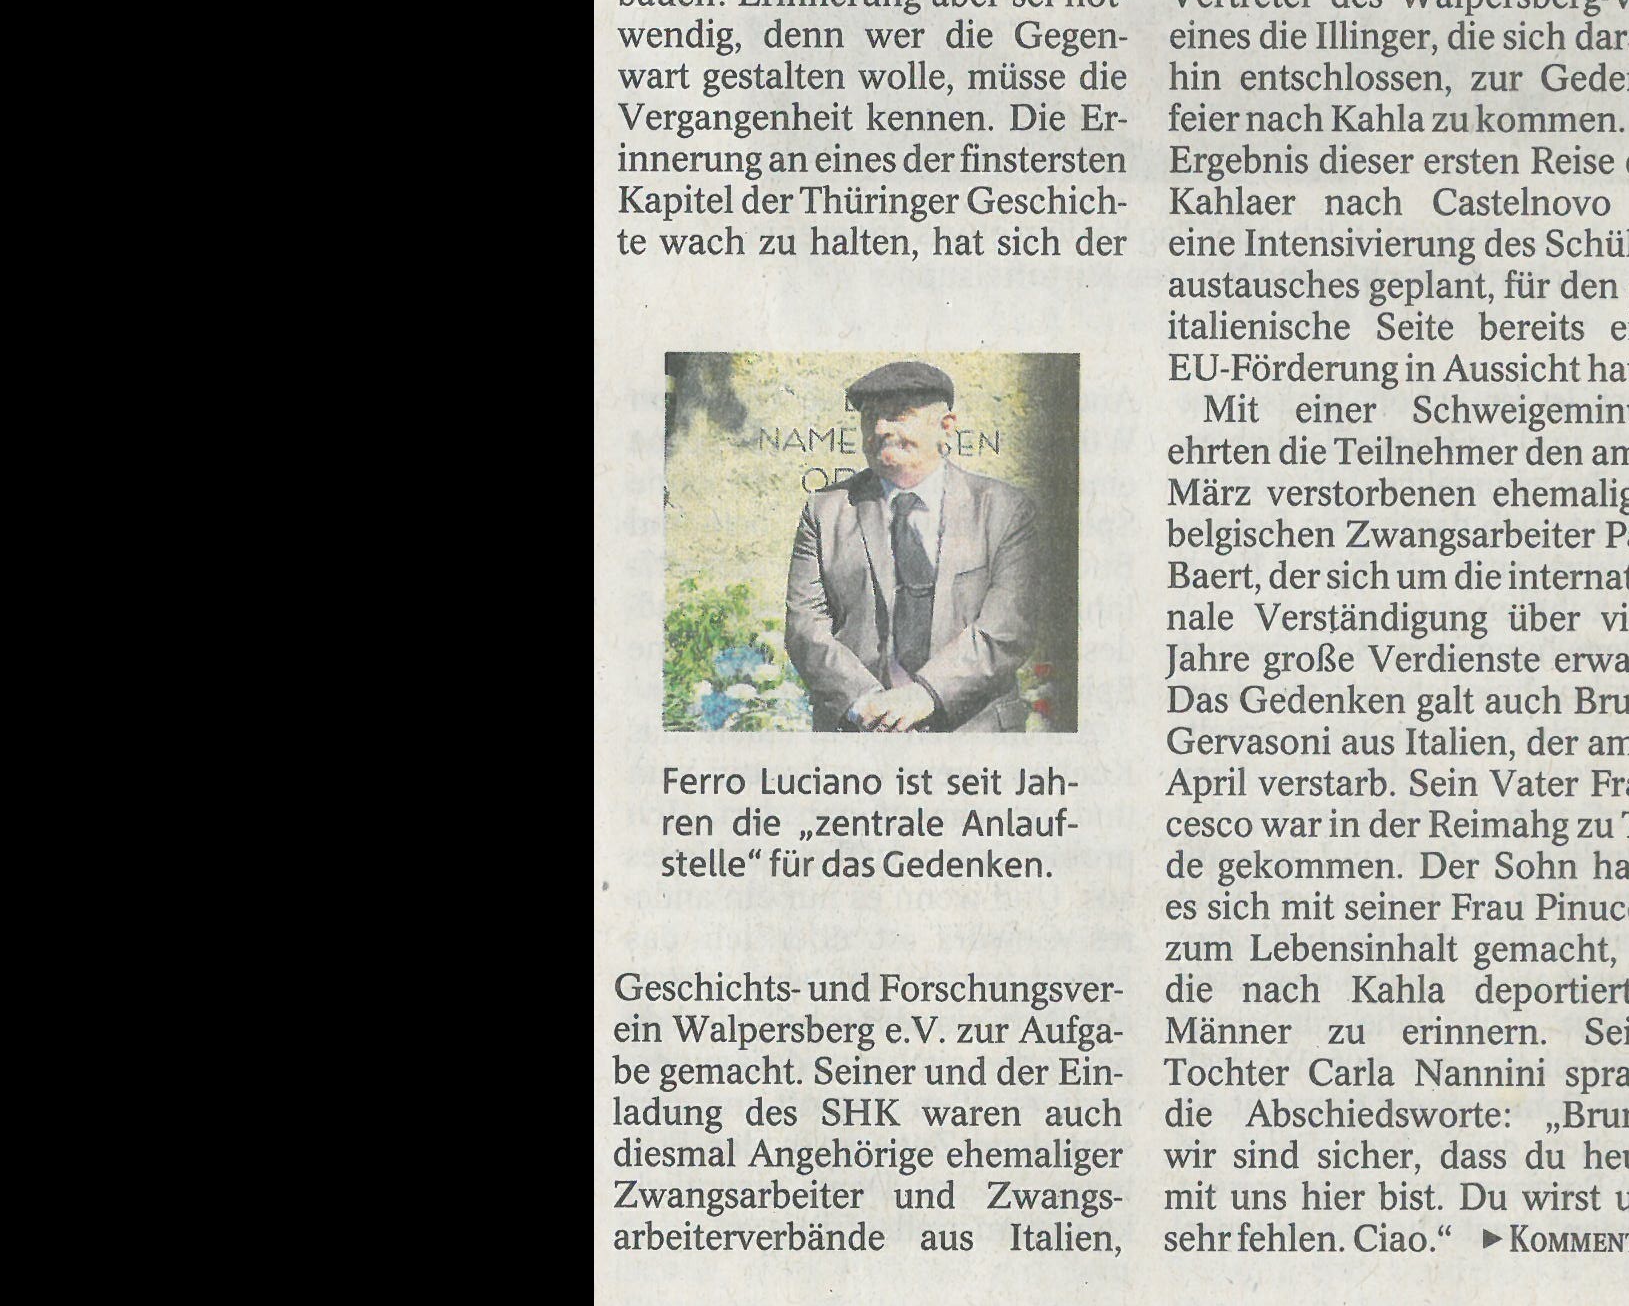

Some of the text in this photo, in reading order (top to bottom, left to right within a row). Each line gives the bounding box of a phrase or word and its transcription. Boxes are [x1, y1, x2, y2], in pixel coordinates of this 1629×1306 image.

[1168, 351, 1399, 391] EU-Förderung
[1405, 352, 1437, 382] in
[1442, 352, 1581, 383] Aussicht
[1164, 642, 1250, 680] Jahre
[1263, 642, 1355, 681] große
[1367, 642, 1541, 674] Verdienste
[663, 766, 1079, 796] Ferro Luciano ist seit Jah-
[662, 814, 713, 837] ren
[732, 806, 781, 837] die
[961, 807, 1079, 838] Anlauf-
[769, 847, 815, 878] für
[821, 848, 876, 878] das
[883, 848, 1053, 879] Gedenken.
[613, 1220, 1122, 1258] arbeiterverbände aus Italien,
[1164, 1222, 1232, 1252] sehr
[1237, 1221, 1345, 1253] fehlen.
